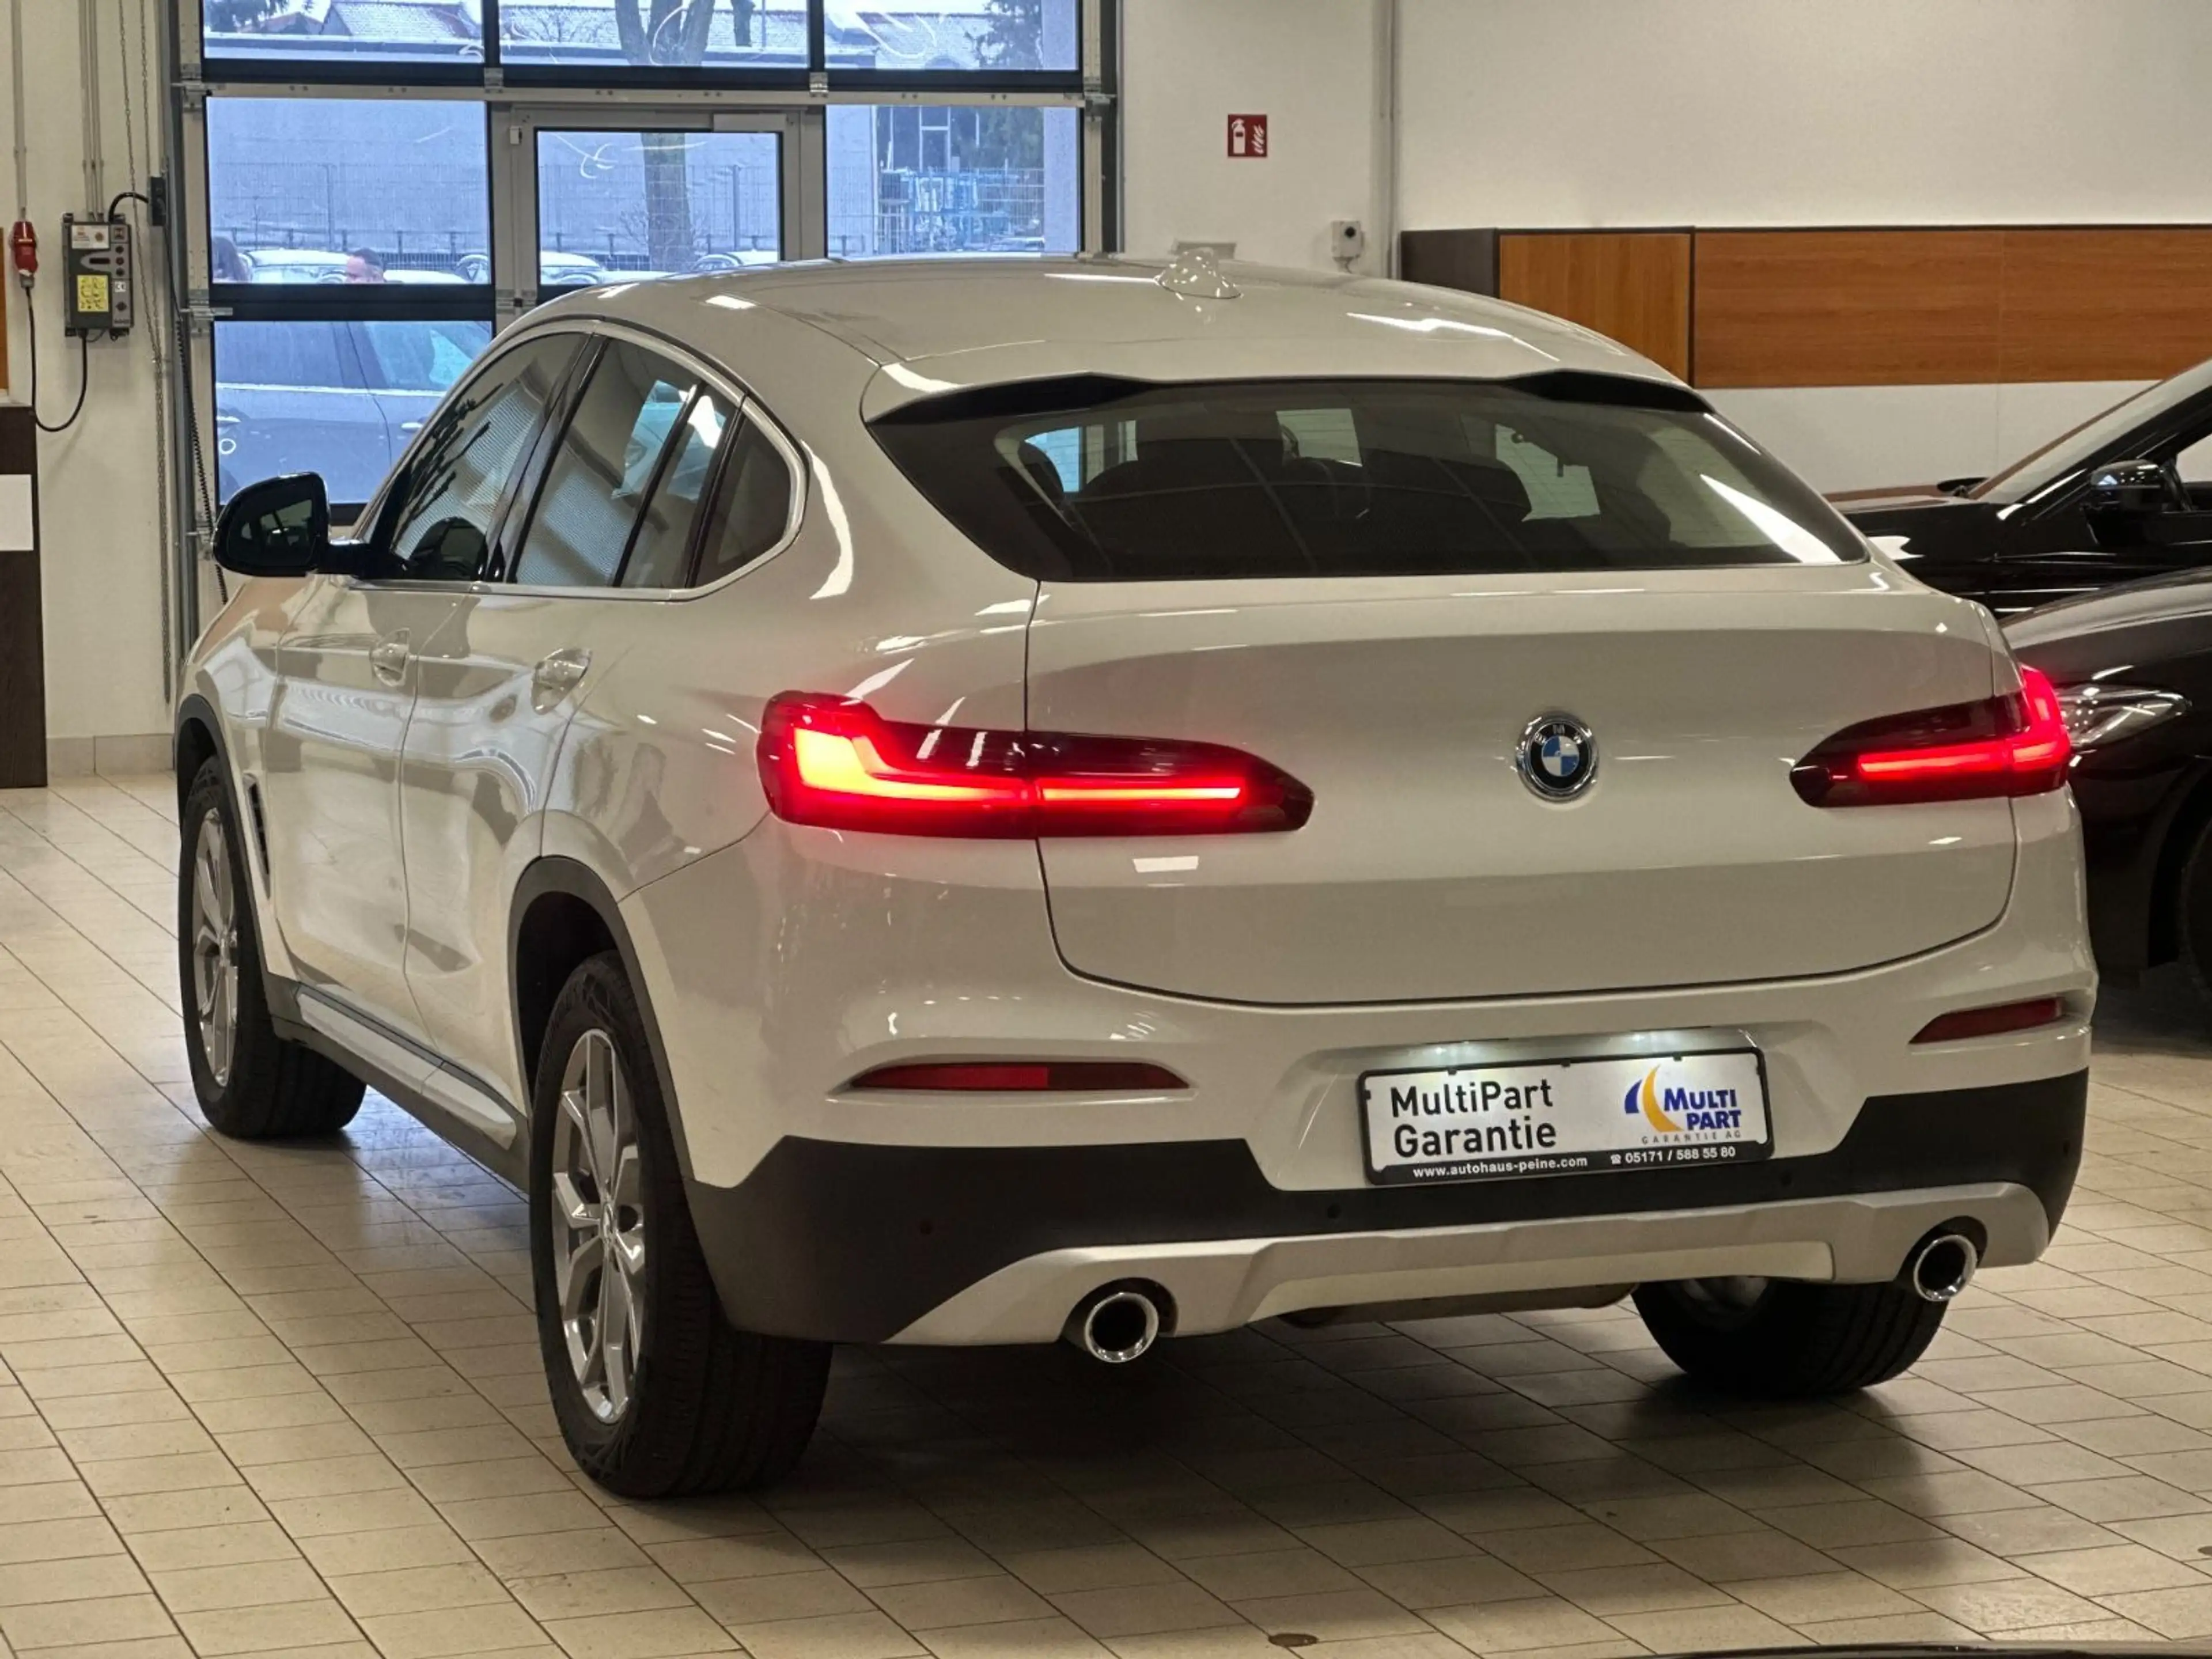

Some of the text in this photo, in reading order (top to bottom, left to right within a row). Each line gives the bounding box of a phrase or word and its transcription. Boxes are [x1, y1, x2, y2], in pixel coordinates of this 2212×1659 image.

[1390, 1078, 1554, 1118] MultiPart
[1687, 1109, 1742, 1131] PART
[1394, 1115, 1557, 1158] Garantie
[1642, 1130, 1742, 1145] GARANTIE AG
[1625, 1151, 1663, 1164] 05171
[1676, 1149, 1700, 1160] 588
[1703, 1147, 1718, 1159] 55
[1721, 1146, 1736, 1158] 80
[1412, 1157, 1588, 1178] www.autohaus-peine.com
